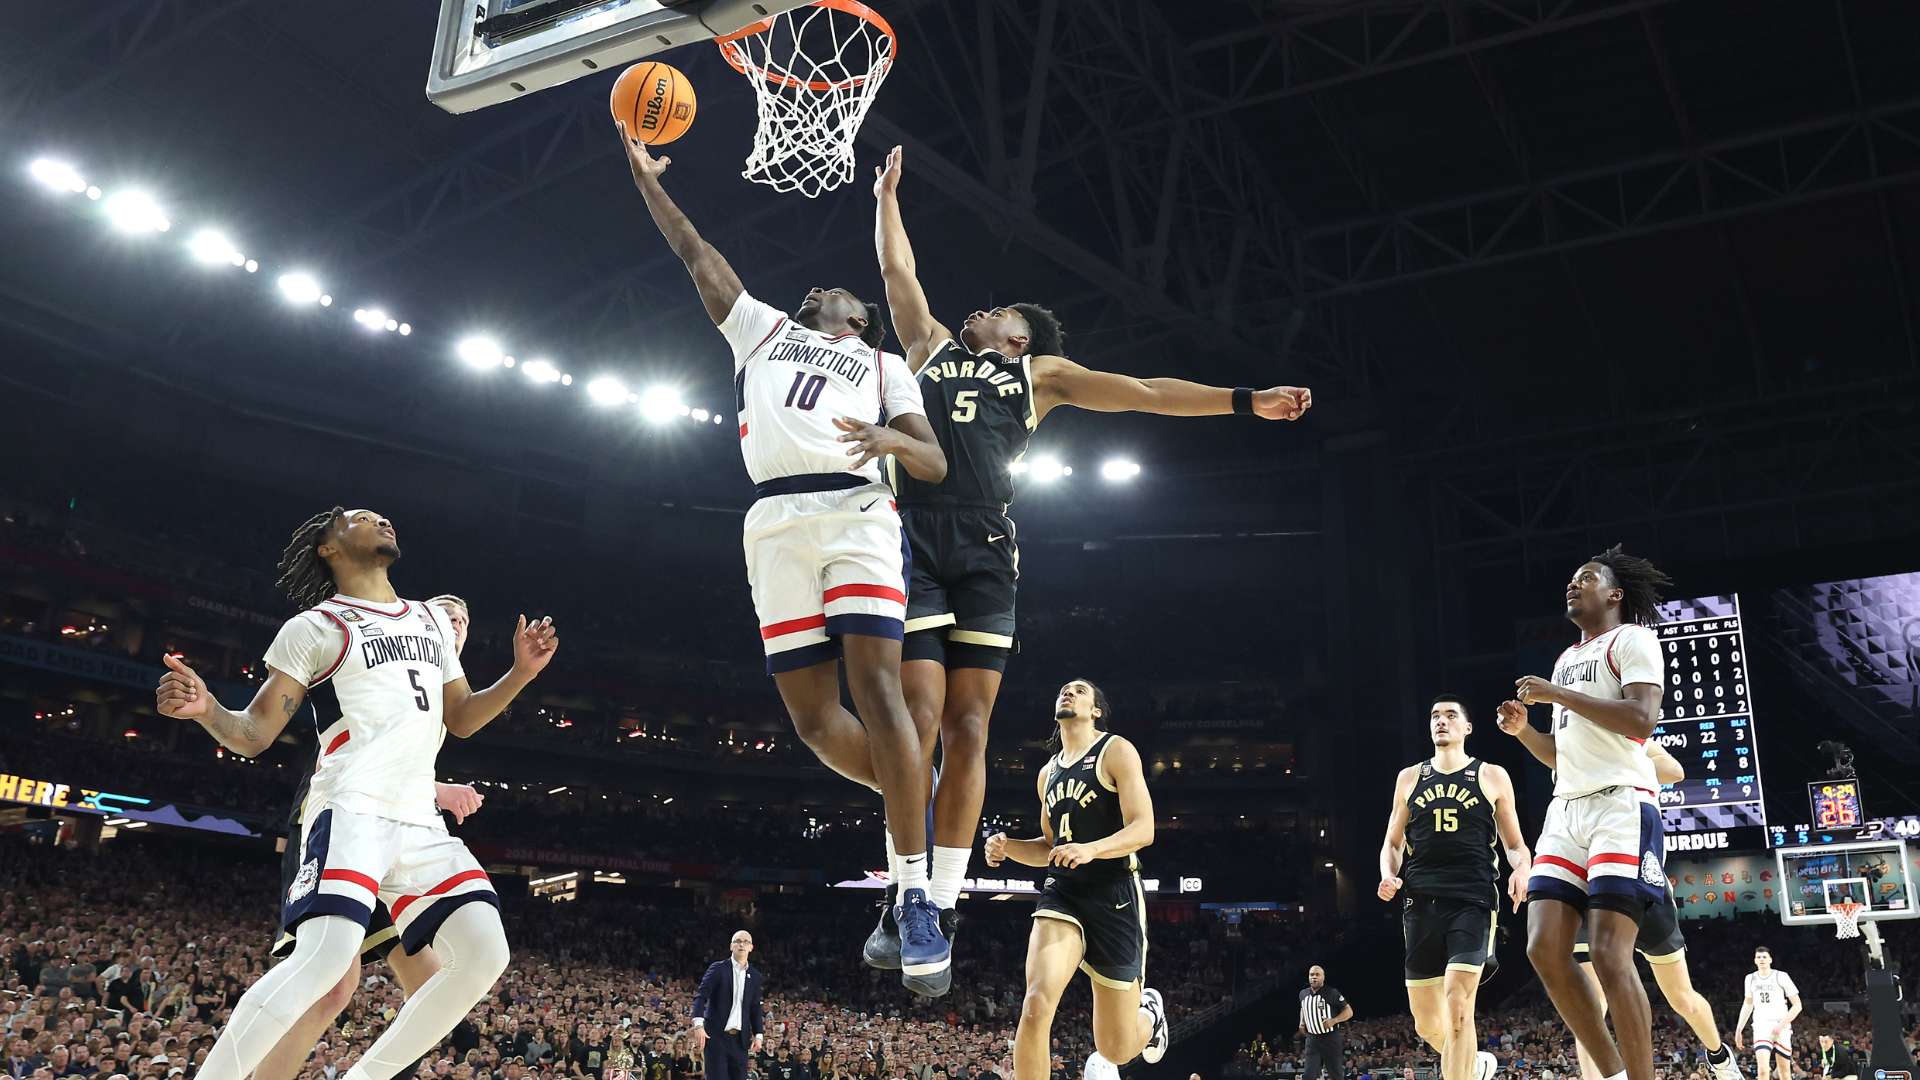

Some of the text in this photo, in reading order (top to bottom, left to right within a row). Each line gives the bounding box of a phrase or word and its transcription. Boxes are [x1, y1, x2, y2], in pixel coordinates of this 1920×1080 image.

[641, 78, 667, 130] Wilson
[767, 341, 870, 387] CONNECTICUT
[924, 360, 1023, 398] PURDUE
[784, 370, 827, 411] 10
[951, 389, 979, 423] 5
[1663, 620, 1738, 635] AST STL BLK FLS
[1668, 635, 1737, 653] 0 1 0 1
[1670, 651, 1740, 669] 4 1 0 0
[1672, 667, 1742, 686] 0 0 1 2
[407, 669, 430, 712] 5
[1674, 683, 1744, 702] 0 0 0 0
[1675, 706, 1685, 718] 0
[1696, 704, 1705, 716] 0
[1716, 702, 1726, 714] 2
[1737, 700, 1746, 712] 2
[1700, 722, 1715, 730] REB
[1731, 719, 1747, 727] BLK
[1701, 731, 1717, 744] 22
[1736, 728, 1744, 740] 3
[1702, 747, 1749, 758] AST TO
[1706, 756, 1749, 771] 4 8
[1706, 778, 1722, 787] STL
[1736, 775, 1755, 784] POT
[0, 774, 70, 807] HERE
[1414, 783, 1479, 810] PURDUE
[1660, 785, 1752, 805] 8%) 2 9
[1822, 783, 1856, 799] 9:29
[1433, 808, 1458, 832] 15
[1821, 797, 1856, 826] 26
[1059, 812, 1073, 842] 4
[1794, 824, 1809, 832] FLS
[1894, 819, 1920, 836] 40
[1665, 832, 1729, 852] URDUE
[1774, 832, 1808, 846] 3 5
[1185, 880, 1200, 890] CC
[1759, 992, 1770, 1004] 32
